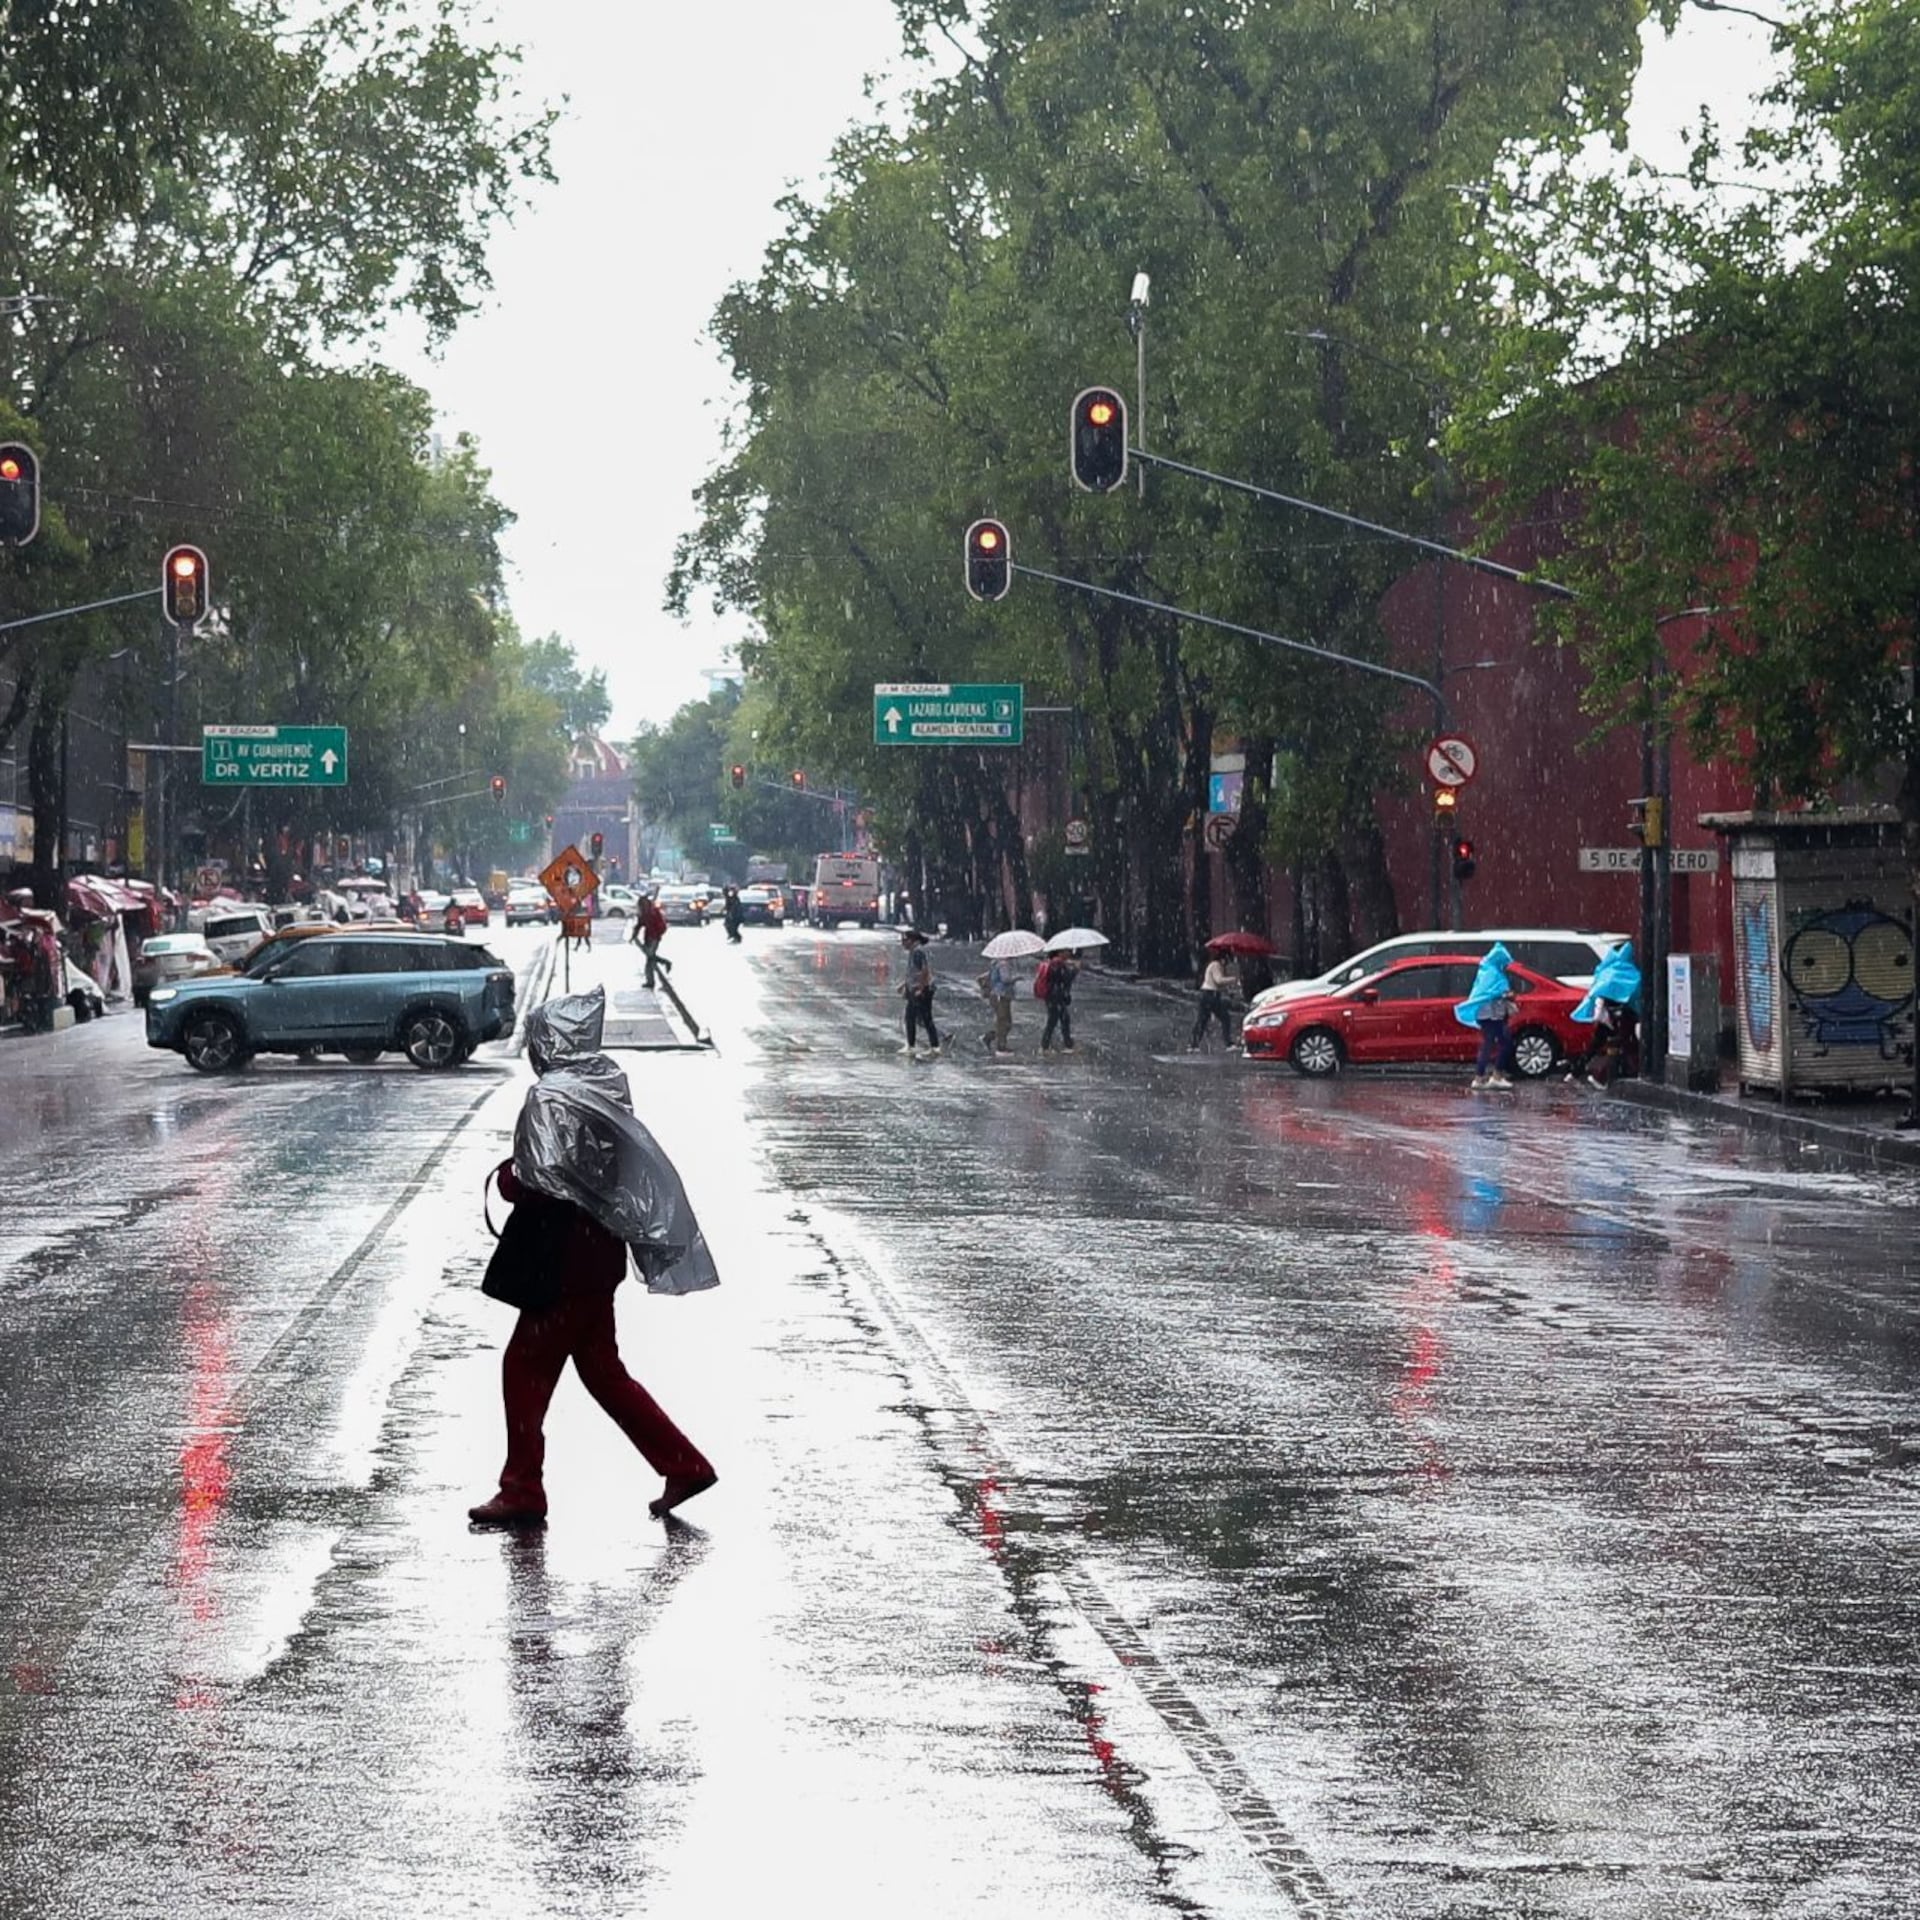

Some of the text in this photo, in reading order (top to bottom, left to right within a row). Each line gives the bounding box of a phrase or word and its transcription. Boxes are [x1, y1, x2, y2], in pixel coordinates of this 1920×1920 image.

[908, 702, 988, 717] LAZARO CARDENAS
[957, 724, 995, 734] CENTRAL
[237, 744, 249, 757] AV
[215, 763, 310, 777] DR VERTIZ
[1590, 852, 1600, 868] 5
[1608, 852, 1628, 868] DE
